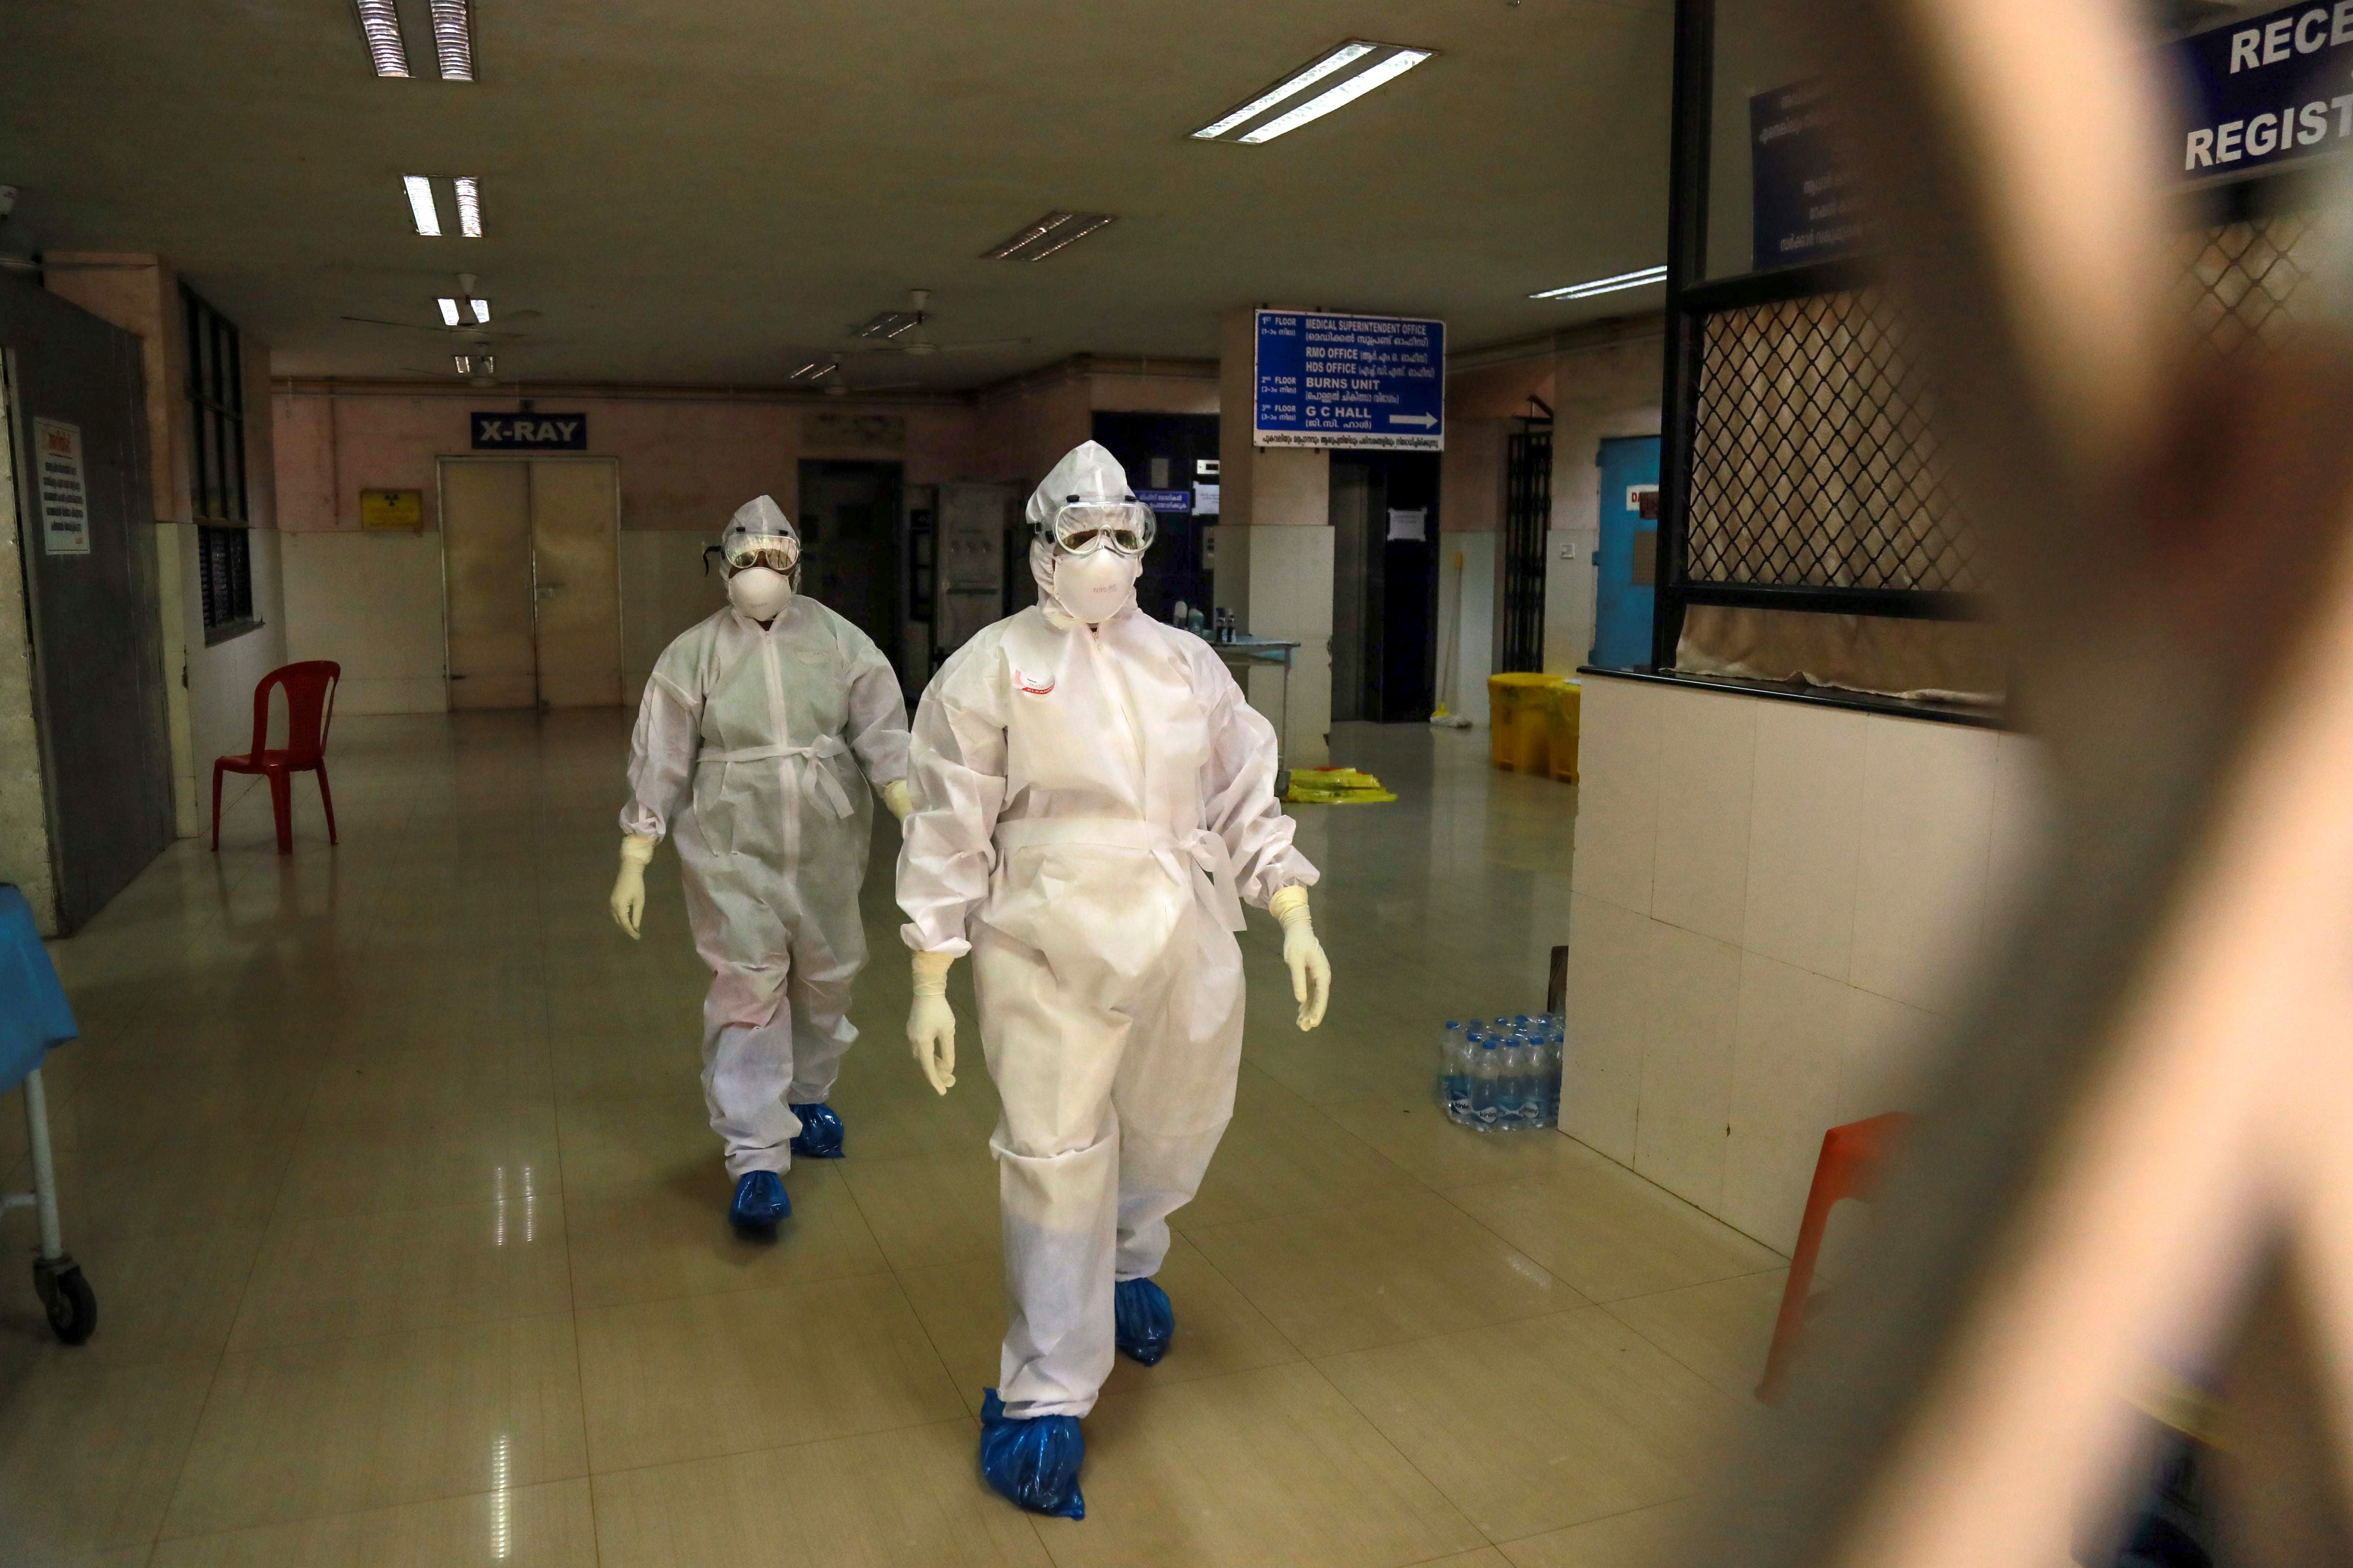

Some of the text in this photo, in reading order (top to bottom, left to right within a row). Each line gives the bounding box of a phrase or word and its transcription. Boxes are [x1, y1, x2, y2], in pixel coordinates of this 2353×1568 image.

[2230, 0, 2353, 74] RECE
[2185, 94, 2353, 170] REGIST
[1275, 317, 1296, 326] FLOOR
[1306, 319, 1426, 335] MEDICAL SUPERINTENDENT OFFICE
[1306, 347, 1358, 359] RMO OFFICE
[1306, 361, 1356, 373] HDS OFFICE
[1275, 376, 1296, 384] FLOOR
[1306, 377, 1380, 390] BURNS UNIT
[1306, 406, 1371, 418] G C HALL
[480, 421, 578, 441] X-RAY
[1455, 1101, 1469, 1110] kinle
